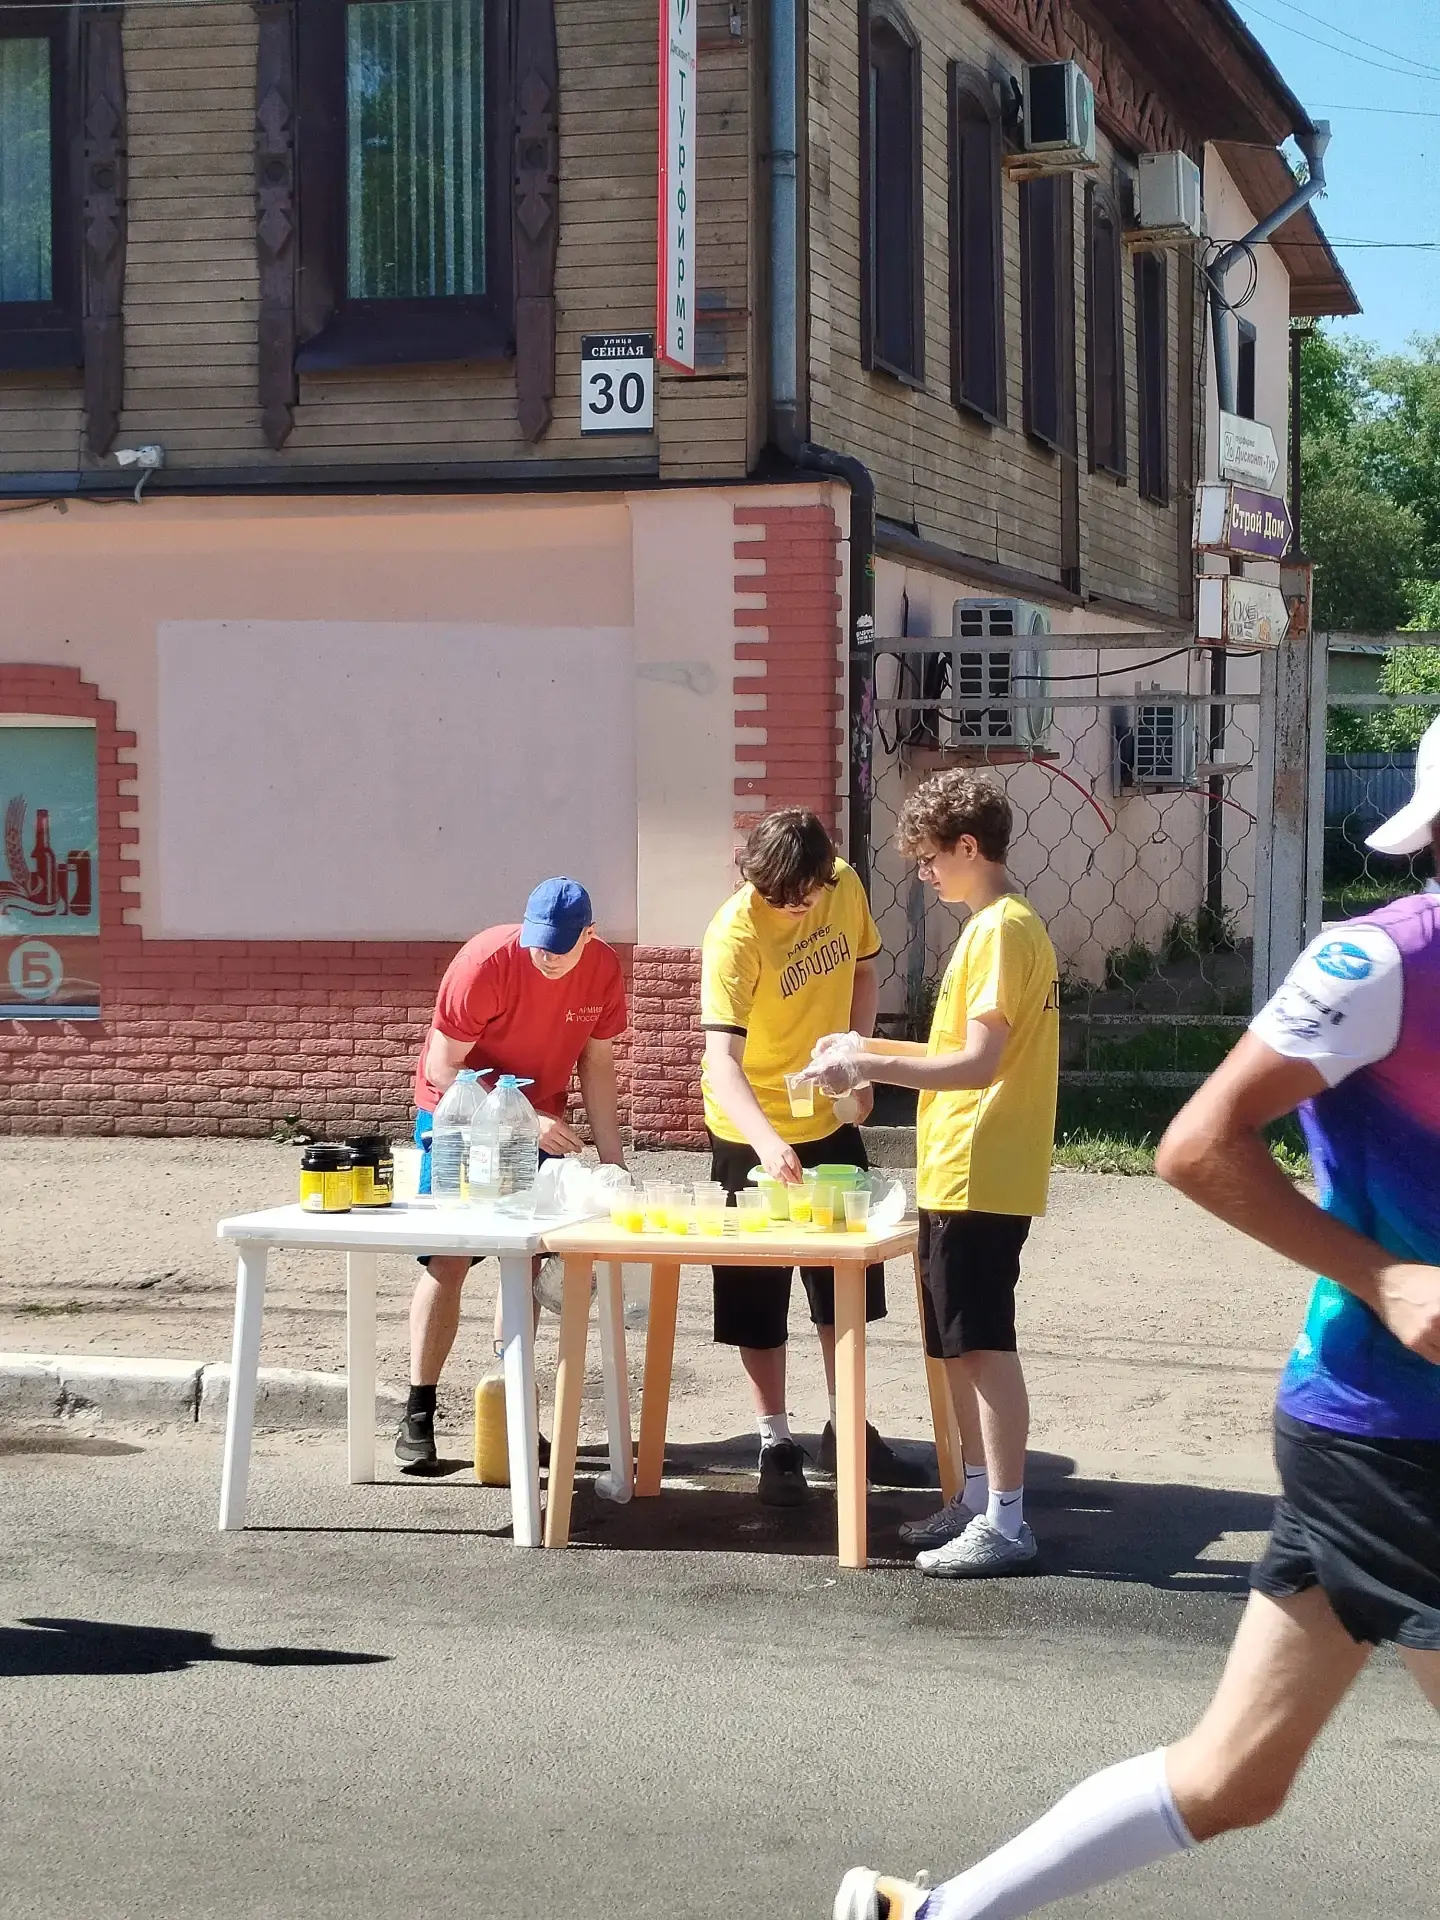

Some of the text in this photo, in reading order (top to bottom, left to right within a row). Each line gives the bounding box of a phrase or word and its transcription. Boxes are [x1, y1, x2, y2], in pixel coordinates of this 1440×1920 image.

[591, 346, 644, 357] СЕННАЯ
[603, 338, 632, 346] улица
[588, 372, 645, 415] 30
[1232, 503, 1285, 540] Строй Дом
[22, 951, 54, 989] Б
